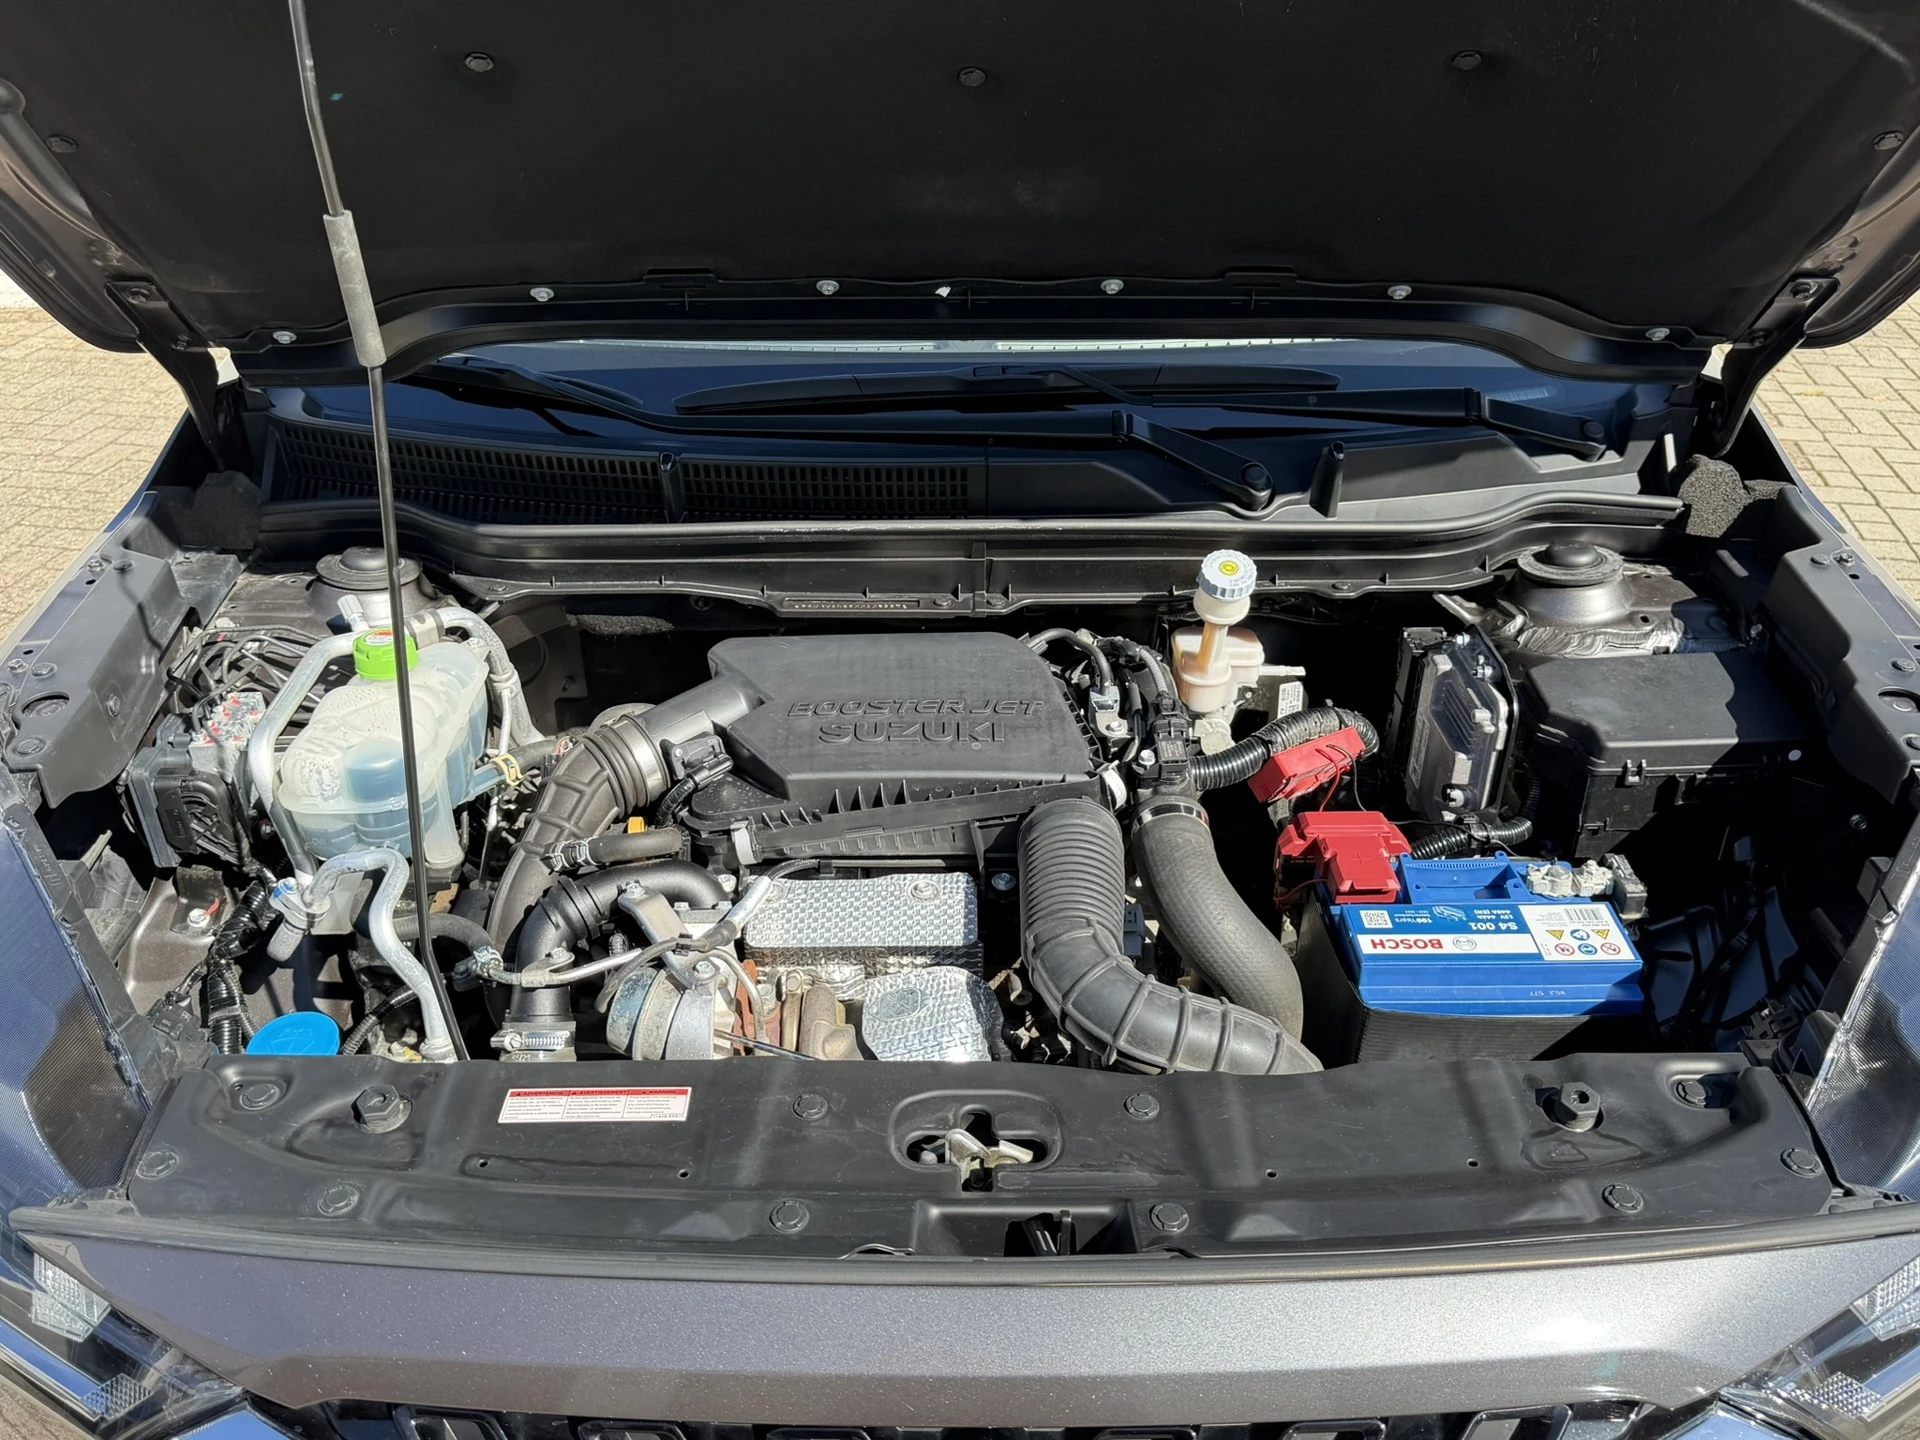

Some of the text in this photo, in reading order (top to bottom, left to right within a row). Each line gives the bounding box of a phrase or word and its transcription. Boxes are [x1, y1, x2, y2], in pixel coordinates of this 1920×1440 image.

[818, 721, 1005, 744] SUZUKI
[1468, 921, 1518, 931] S4 001
[1370, 938, 1444, 950] BOSCH
